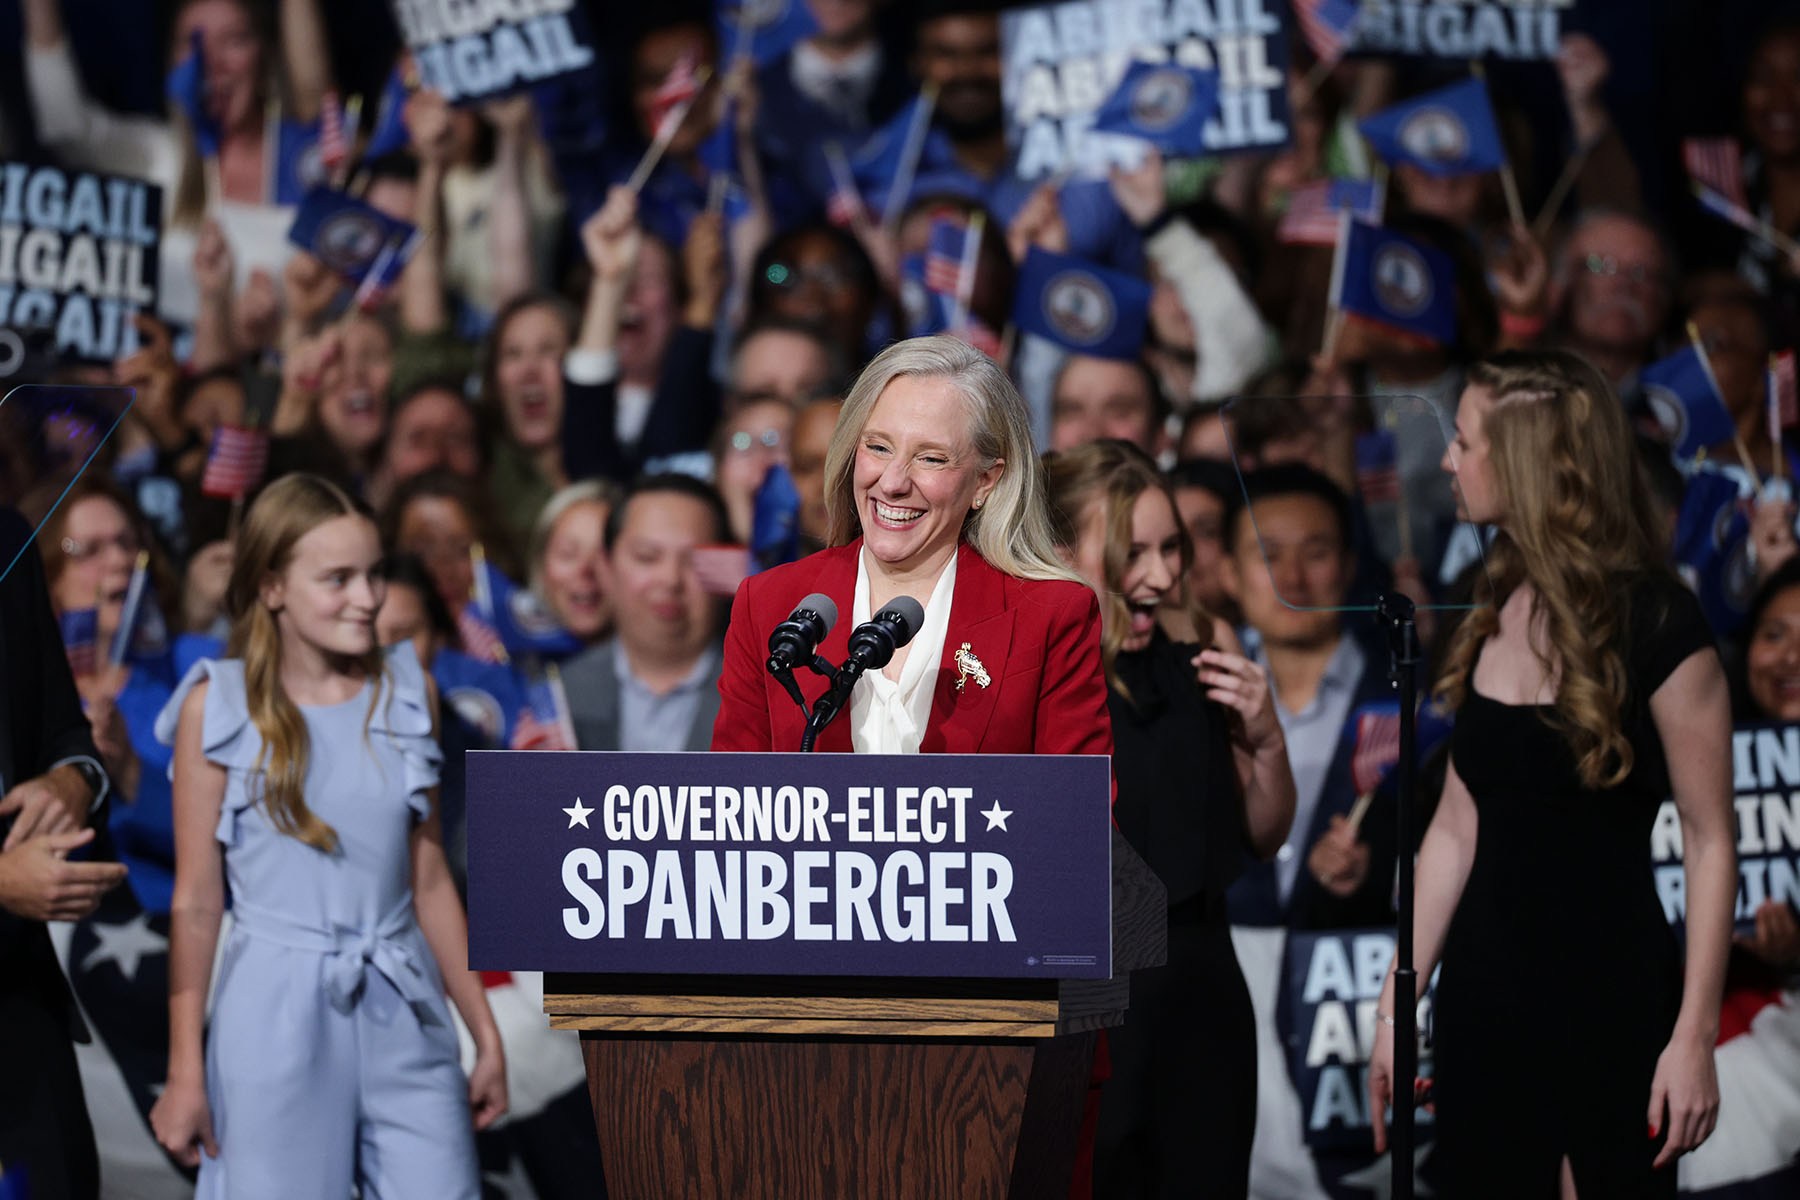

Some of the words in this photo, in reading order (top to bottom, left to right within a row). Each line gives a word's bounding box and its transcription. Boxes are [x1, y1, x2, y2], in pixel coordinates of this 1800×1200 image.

[420, 14, 595, 100] IGAIL
[0, 162, 157, 246] IGAIL
[603, 784, 974, 843] GOVERNOR-ELECT
[561, 847, 1018, 942] SPANBERGER
